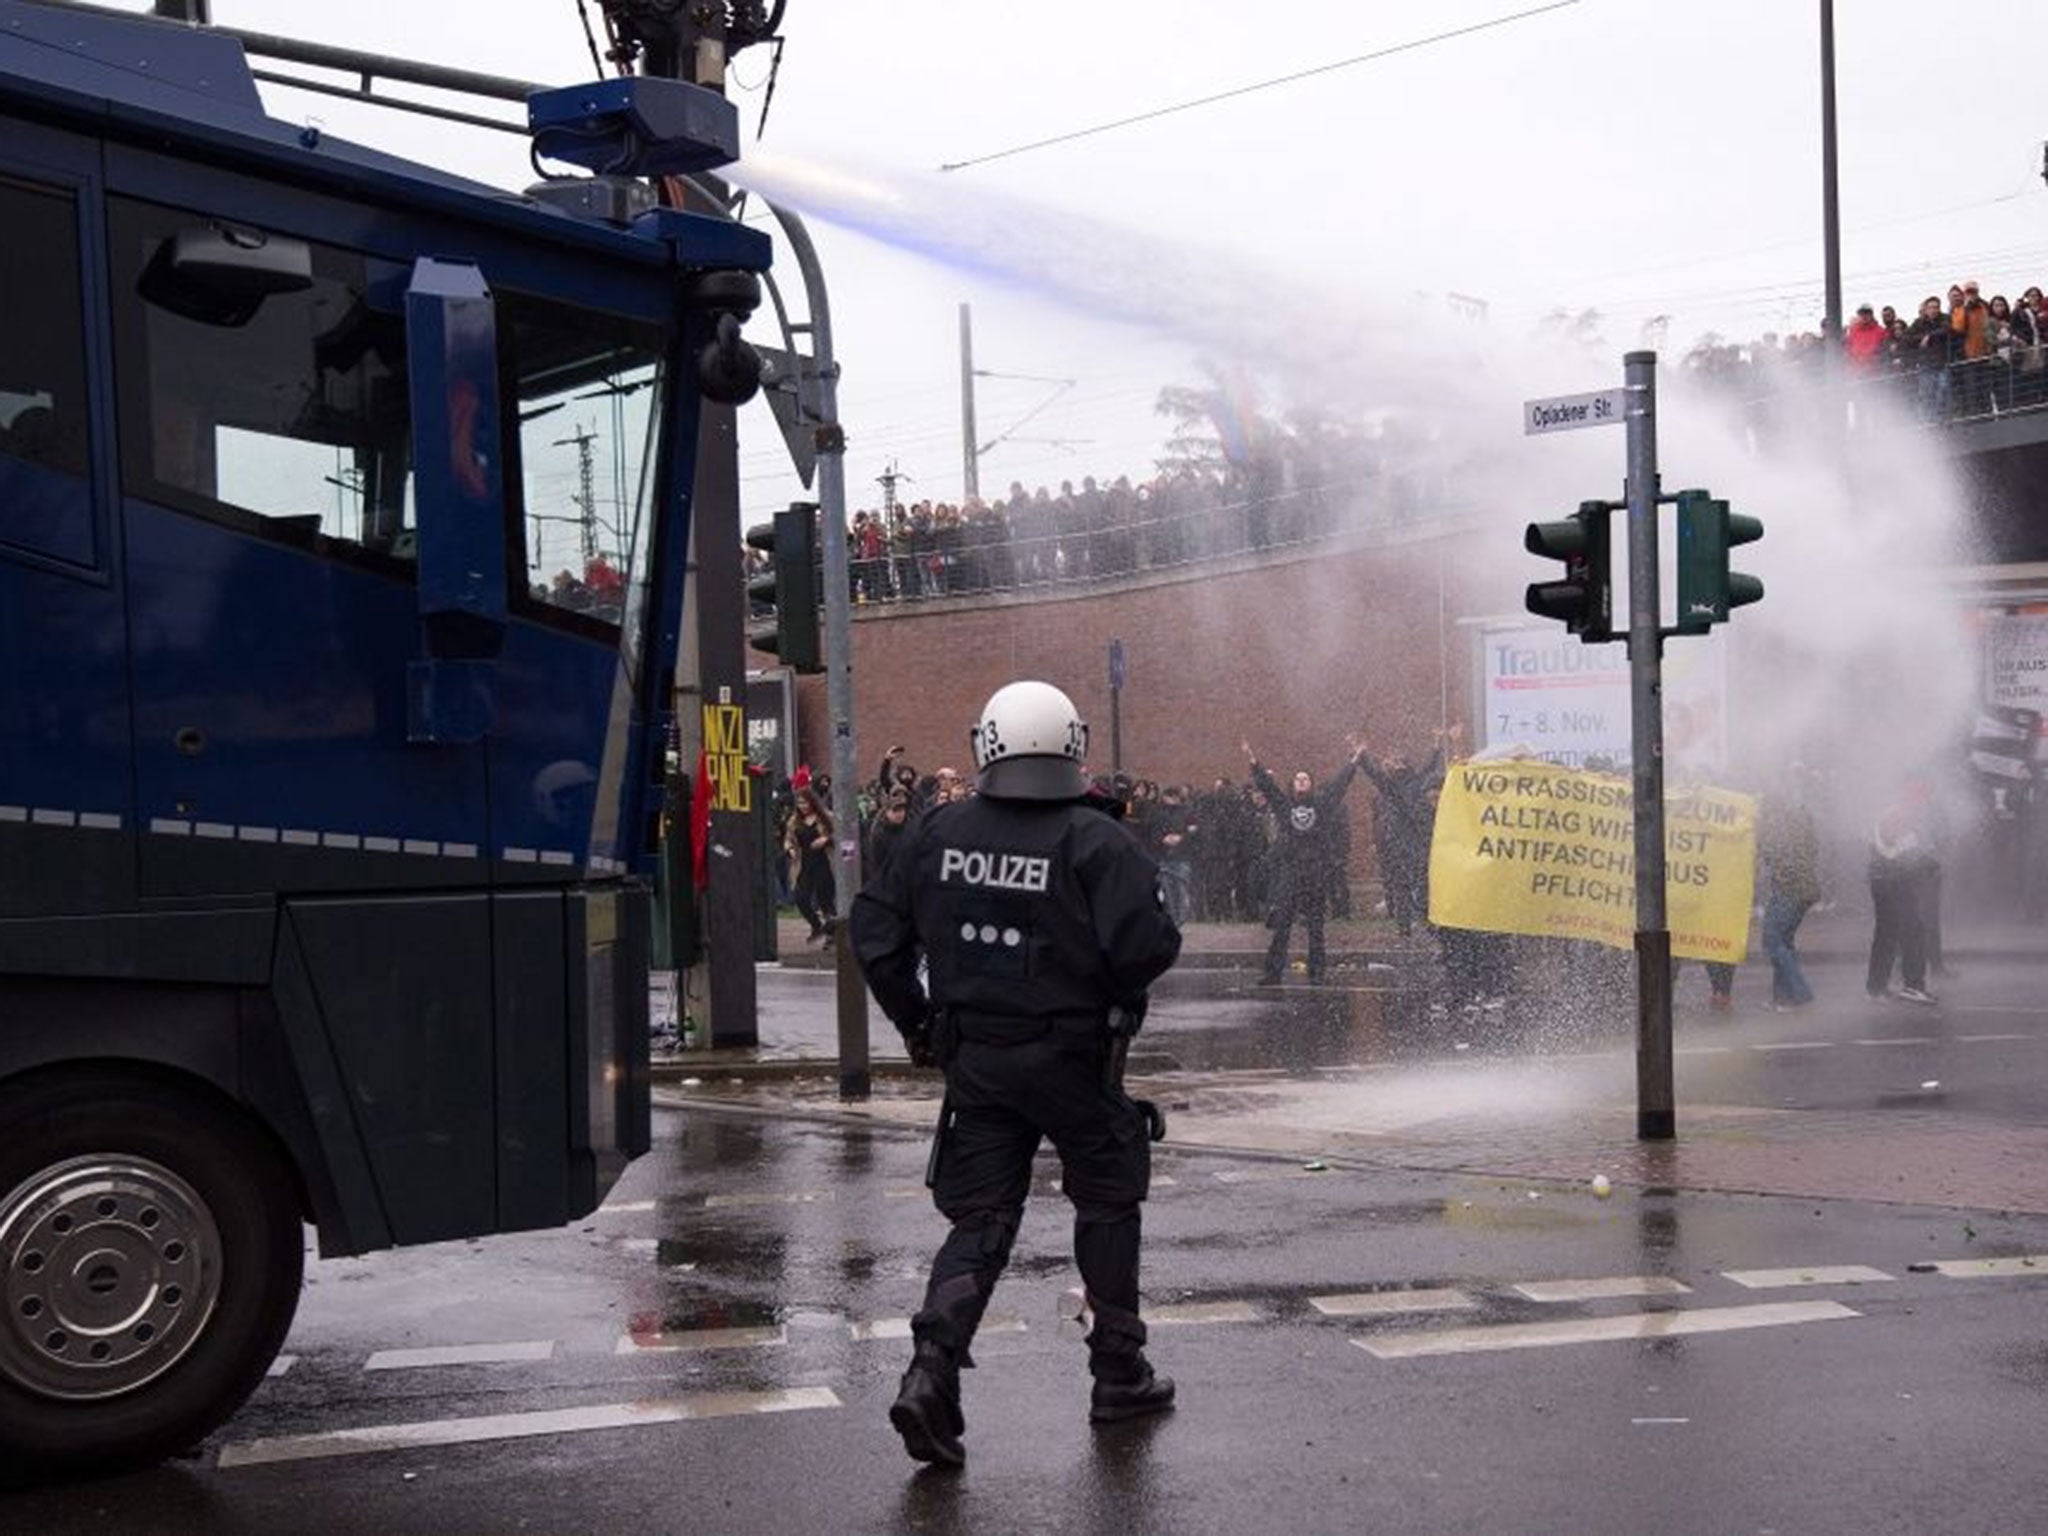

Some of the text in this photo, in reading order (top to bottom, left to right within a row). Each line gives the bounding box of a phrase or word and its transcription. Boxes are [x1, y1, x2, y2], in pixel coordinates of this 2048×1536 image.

[1533, 402, 1589, 428] Opladener
[981, 720, 999, 749] 13
[1463, 770, 1508, 795] WO
[1516, 776, 1634, 810] RASSISM
[1480, 805, 1711, 854] ALLTAG WIR IST
[941, 848, 1049, 891] POLIZEI
[1476, 836, 1709, 886] ANTIFASCHIUS
